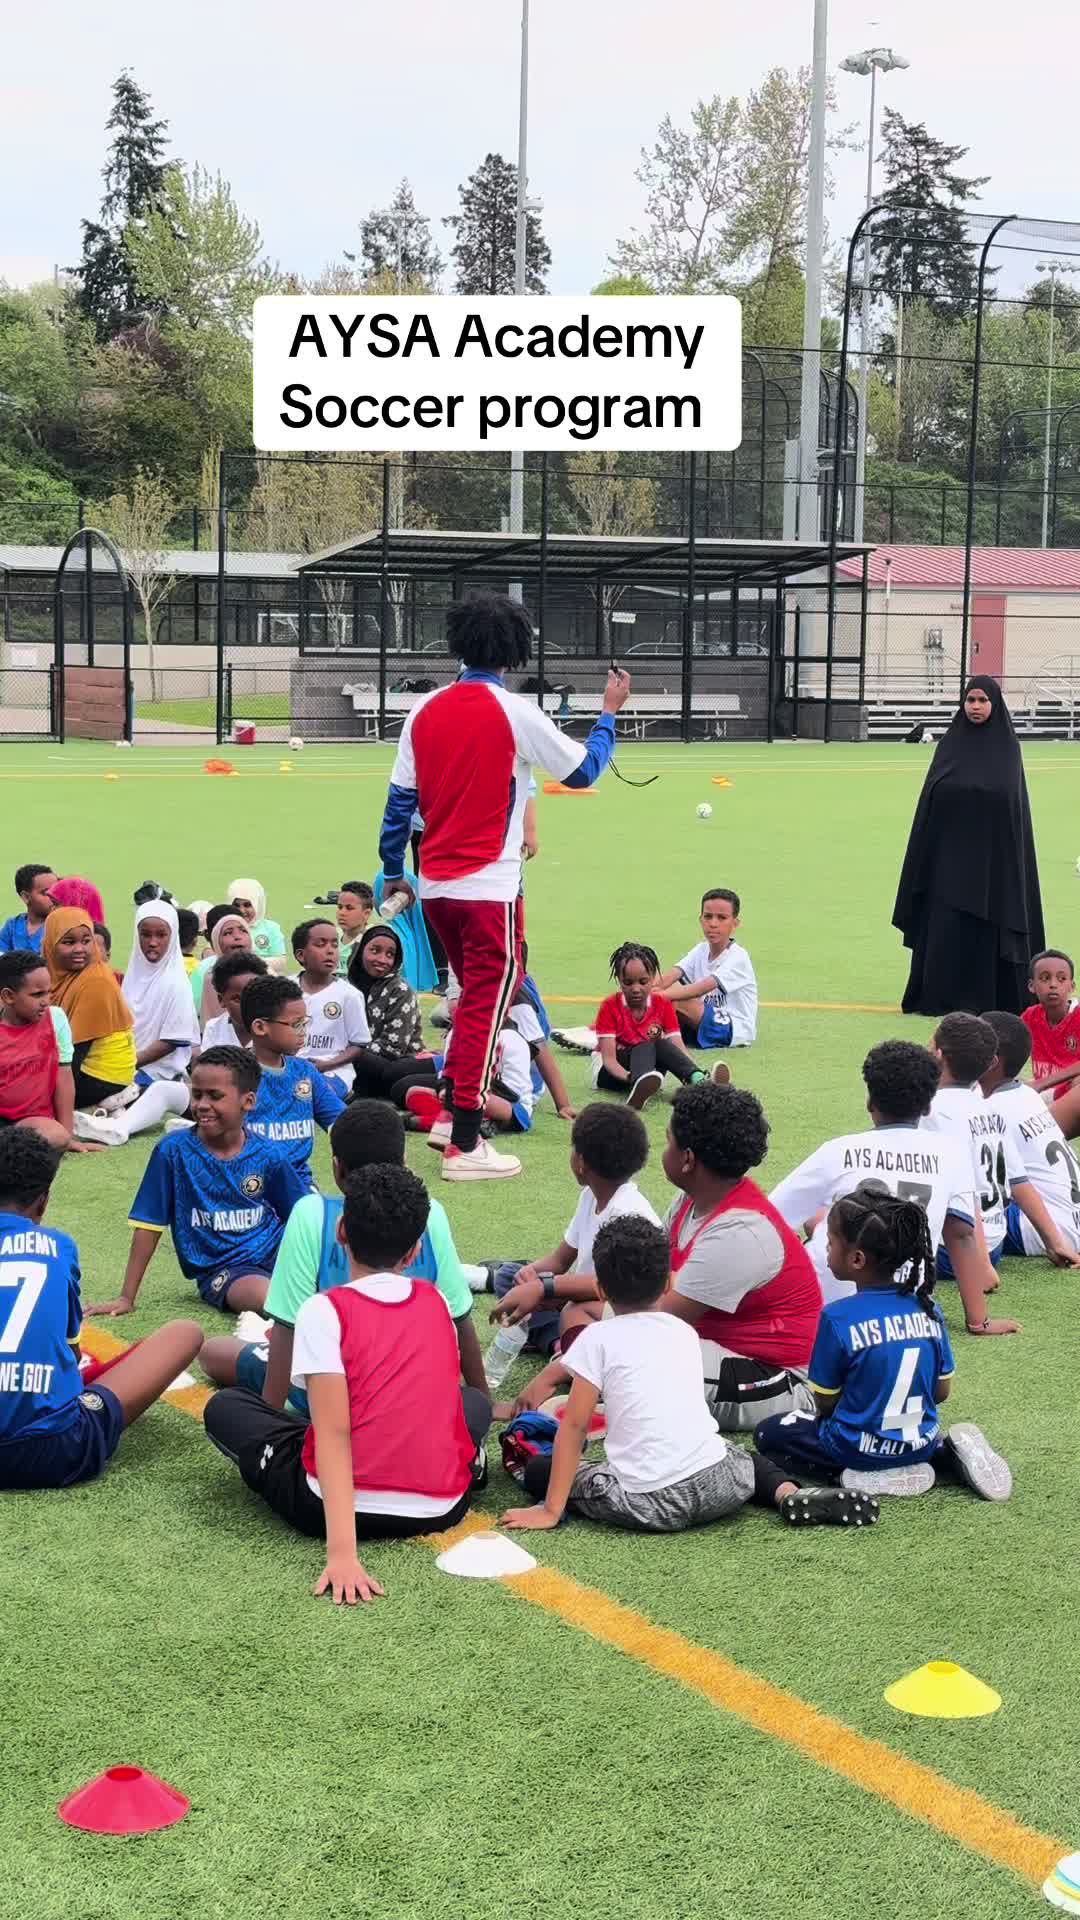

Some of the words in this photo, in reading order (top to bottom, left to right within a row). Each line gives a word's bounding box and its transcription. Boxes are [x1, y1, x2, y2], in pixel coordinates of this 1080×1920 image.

[304, 1034, 335, 1049] ADEMY
[844, 1148, 872, 1169] AYS
[875, 1149, 939, 1174] ACADEMY
[0, 1260, 48, 1353] 7
[849, 1319, 883, 1352] AYS
[22, 1362, 55, 1394] GOT
[881, 1347, 926, 1442] 4
